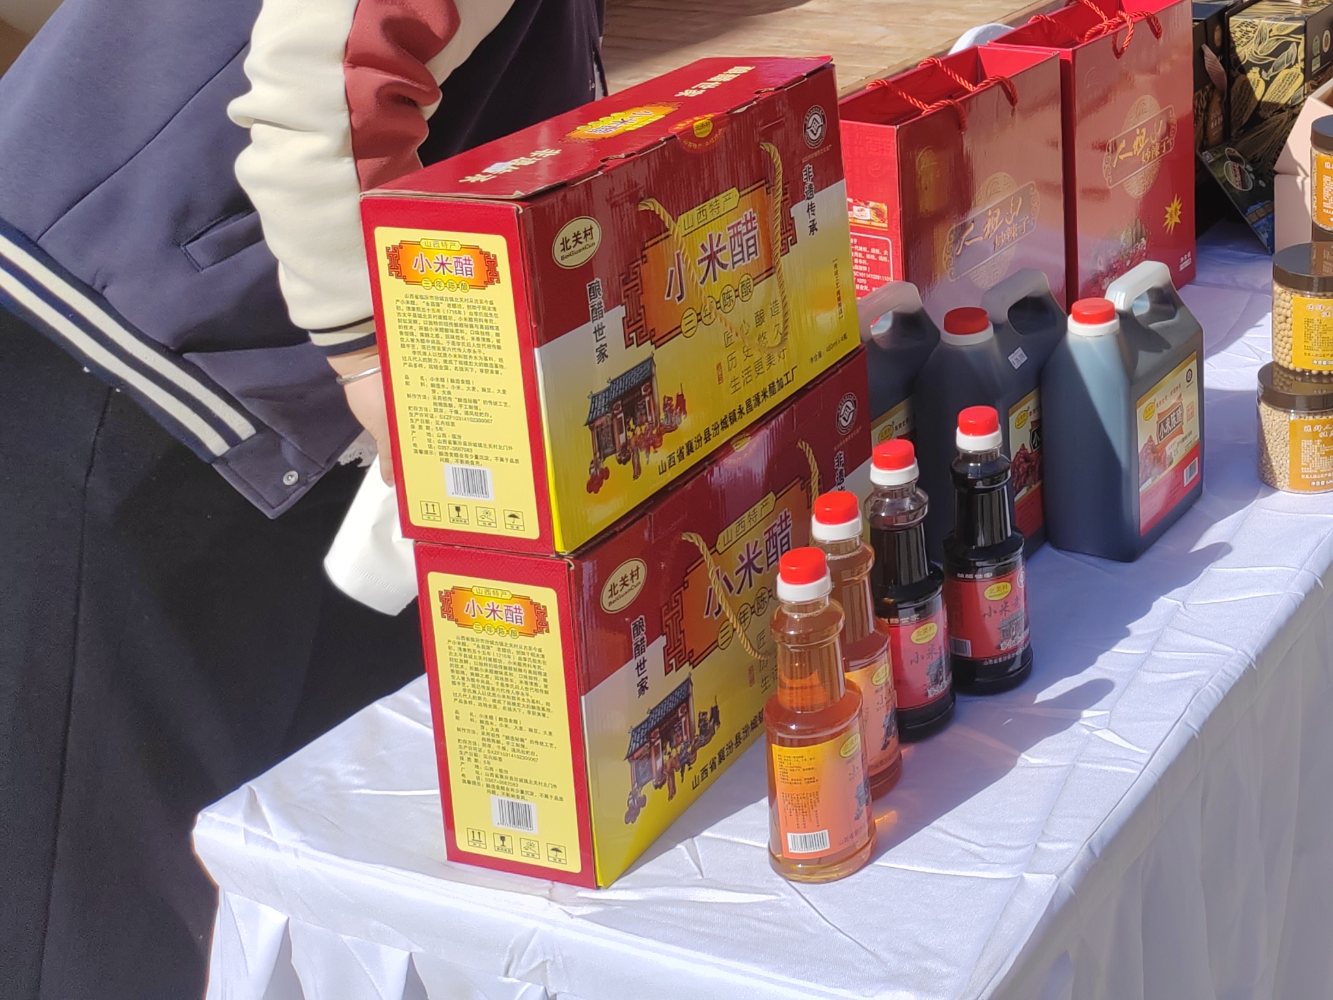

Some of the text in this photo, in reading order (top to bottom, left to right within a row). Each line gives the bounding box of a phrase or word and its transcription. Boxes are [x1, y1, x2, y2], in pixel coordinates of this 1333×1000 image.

[682, 194, 733, 230] 山西特产
[803, 164, 818, 236] 非遗传承
[413, 253, 475, 277] 小米醋
[560, 224, 594, 252] 北关村
[665, 210, 758, 303] 小米醋
[586, 279, 609, 364] 酿醋世家
[721, 500, 769, 546] 山西特产
[607, 565, 640, 597] 北关村
[703, 509, 793, 620] 小米醋
[465, 599, 524, 625] 小米醋
[717, 588, 778, 650] 三年陈
[631, 615, 649, 698] 酿醋世家
